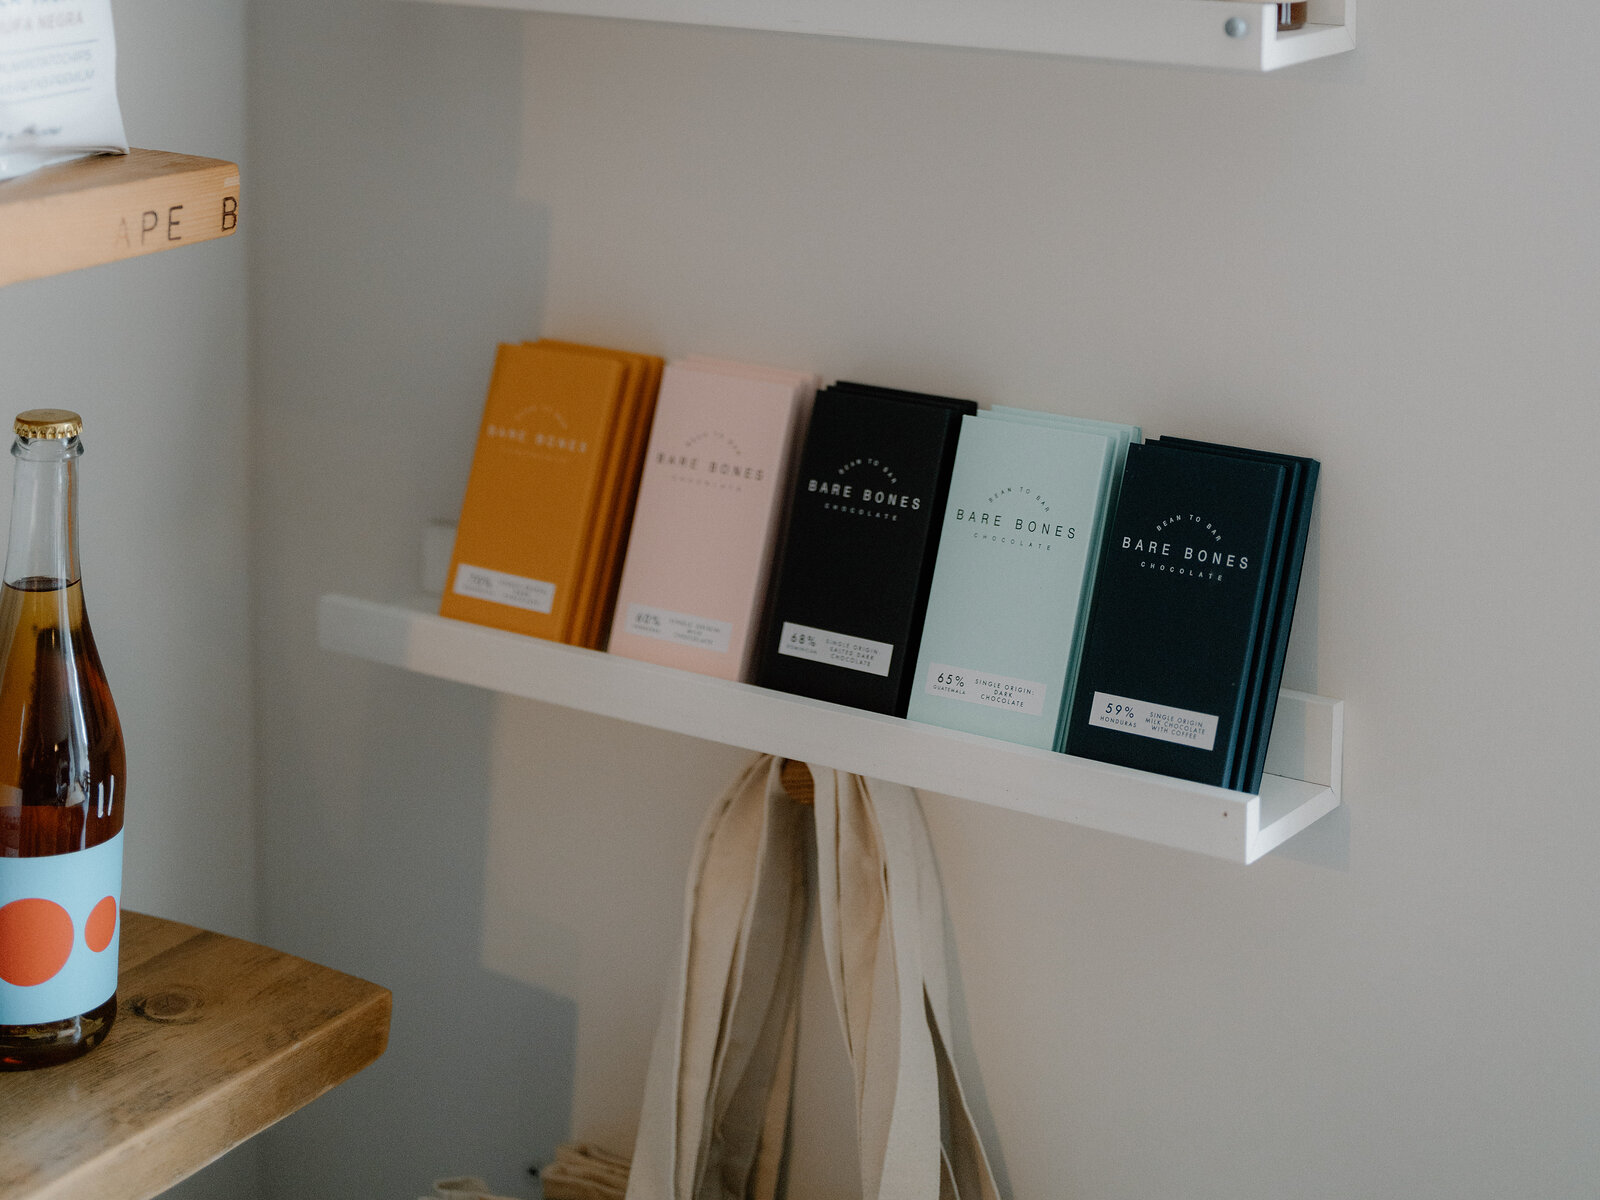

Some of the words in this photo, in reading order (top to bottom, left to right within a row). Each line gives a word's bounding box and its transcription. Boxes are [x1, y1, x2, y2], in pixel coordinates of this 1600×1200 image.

[221, 196, 238, 232] B
[709, 461, 764, 481] BONES
[807, 479, 853, 498] BARE
[862, 488, 921, 510] BONES
[988, 487, 1012, 503] BEAN
[1020, 486, 1031, 494] TO
[1035, 495, 1050, 513] BAR
[824, 502, 898, 521] CHOCOLATE
[956, 508, 1002, 527] BARE
[1015, 518, 1076, 539] BONES
[1156, 514, 1181, 532] BEAN
[1189, 514, 1201, 523] TO
[1206, 523, 1221, 542] BAR
[973, 532, 1051, 551] CHOCOLATE
[1122, 536, 1171, 556] BARE
[1184, 547, 1248, 570] BONES
[1140, 561, 1223, 581] CHOCOLATE
[790, 632, 817, 647] 68%
[826, 638, 850, 649] SINGLE
[831, 653, 871, 667] CHOCOLATE
[937, 672, 965, 688] 65%
[975, 678, 1001, 689] SINGLE
[933, 684, 966, 695] GUATEMALA
[994, 689, 1013, 698] DARK
[980, 693, 1024, 707] CHOCOLATE
[1105, 702, 1134, 719] 59%
[1149, 711, 1174, 722] SINGLE
[1100, 715, 1137, 728] HONDURAS
[1145, 717, 1161, 726] MILK
[1164, 721, 1206, 735] CHOCOLATE
[1151, 725, 1168, 734] WITH
[1171, 728, 1197, 739] COFFEE
